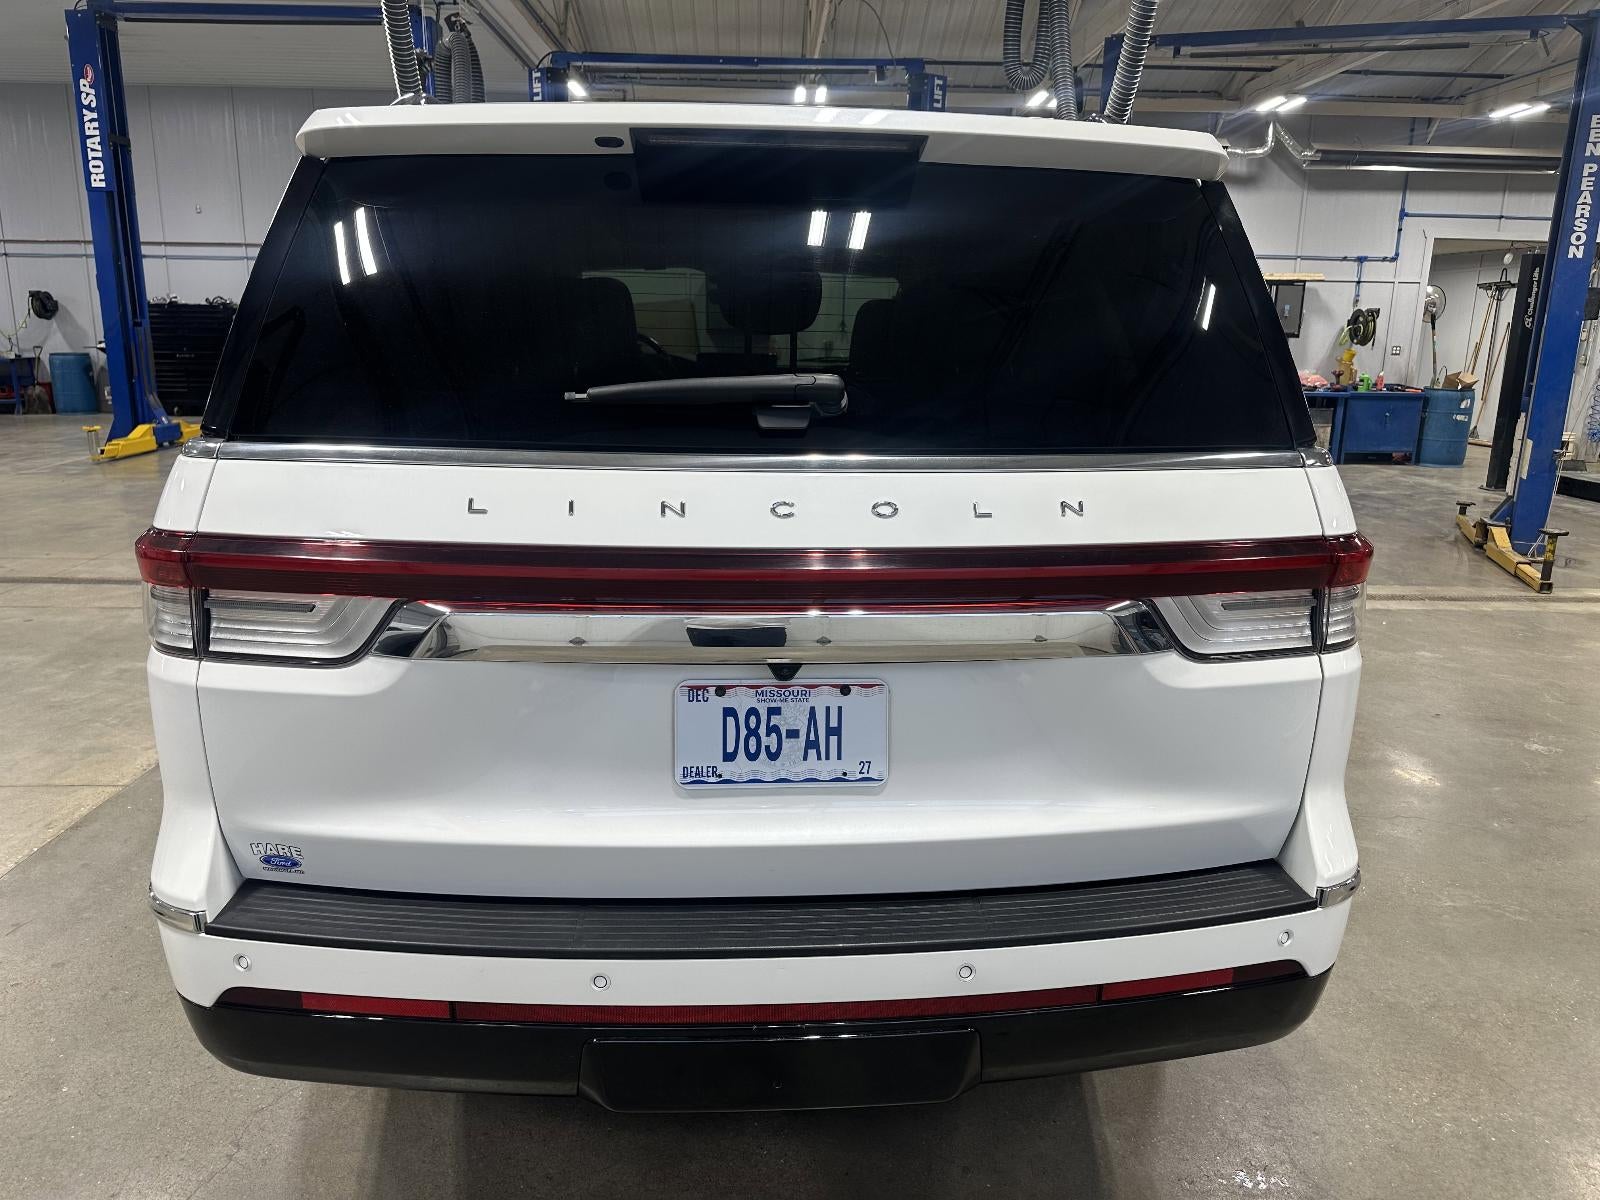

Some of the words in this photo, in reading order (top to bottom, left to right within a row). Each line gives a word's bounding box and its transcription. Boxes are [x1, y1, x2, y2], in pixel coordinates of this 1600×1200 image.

[933, 76, 943, 108] LIFT
[83, 108, 106, 188] ROTARY
[1567, 163, 1598, 259] PEARSON
[1528, 281, 1538, 316] Challenger
[467, 497, 1084, 519] LINCOLN
[687, 688, 709, 703] DEC
[755, 689, 811, 698] MISSOURI
[722, 706, 843, 762] D85-AH
[682, 765, 718, 779] DEALER
[858, 760, 872, 775] 27
[249, 842, 304, 860] HARE
[270, 857, 292, 867] Ford
